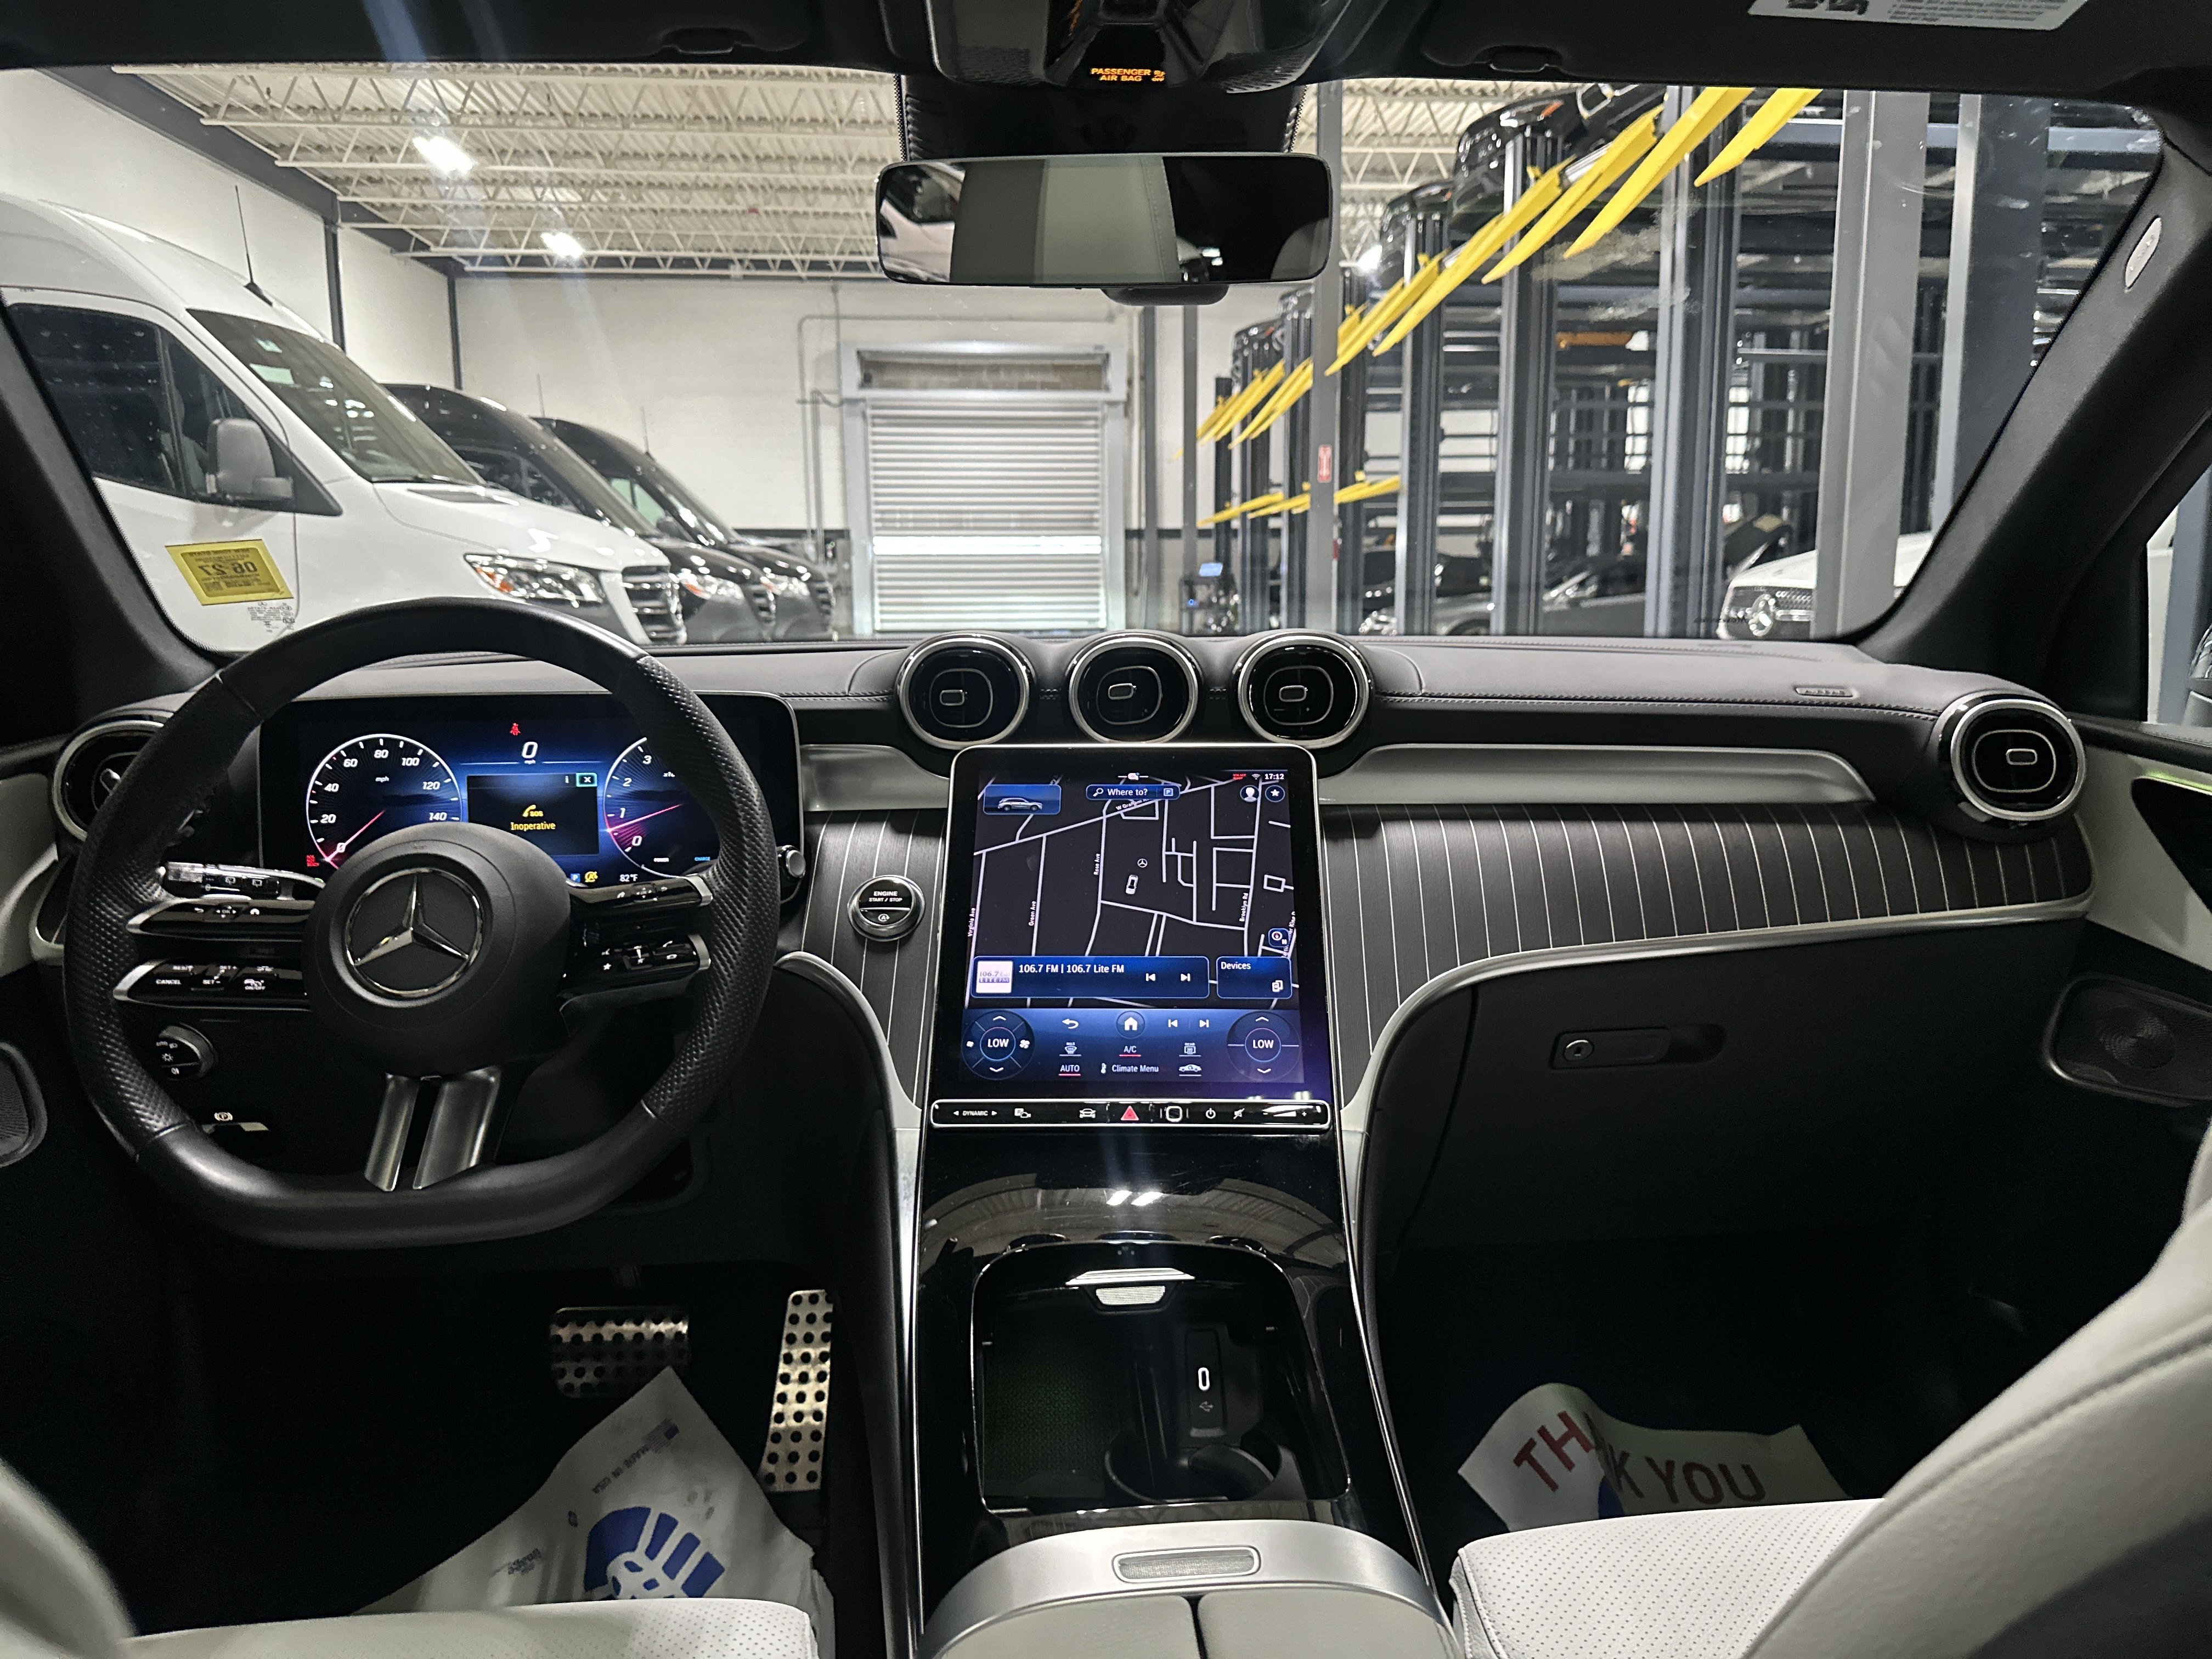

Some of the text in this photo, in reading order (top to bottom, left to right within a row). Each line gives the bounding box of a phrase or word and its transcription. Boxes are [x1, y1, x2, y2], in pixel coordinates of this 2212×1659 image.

[374, 749, 389, 758] 80
[522, 741, 538, 758] 0
[343, 758, 358, 767] 60
[402, 757, 420, 766] 100
[642, 755, 652, 764] 3
[422, 781, 441, 790] 120
[623, 778, 632, 787] 2
[324, 783, 339, 792] 40
[428, 812, 448, 821] 140
[619, 808, 625, 818] 1
[320, 814, 336, 823] 20
[510, 821, 556, 831] Inoperative
[632, 836, 642, 846] 0
[336, 843, 346, 853] 0
[1239, 900, 1248, 922] Brooklyn
[1019, 964, 1043, 973] 106.7
[1046, 964, 1058, 973] FM
[1066, 964, 1091, 973] 106.7
[1093, 964, 1109, 973] Lite
[1111, 964, 1125, 973] FM
[1221, 961, 1251, 969] Devices
[988, 1039, 1009, 1047] LOW
[1252, 1040, 1274, 1048] LOW
[1513, 1410, 1766, 1504] THK YOU
